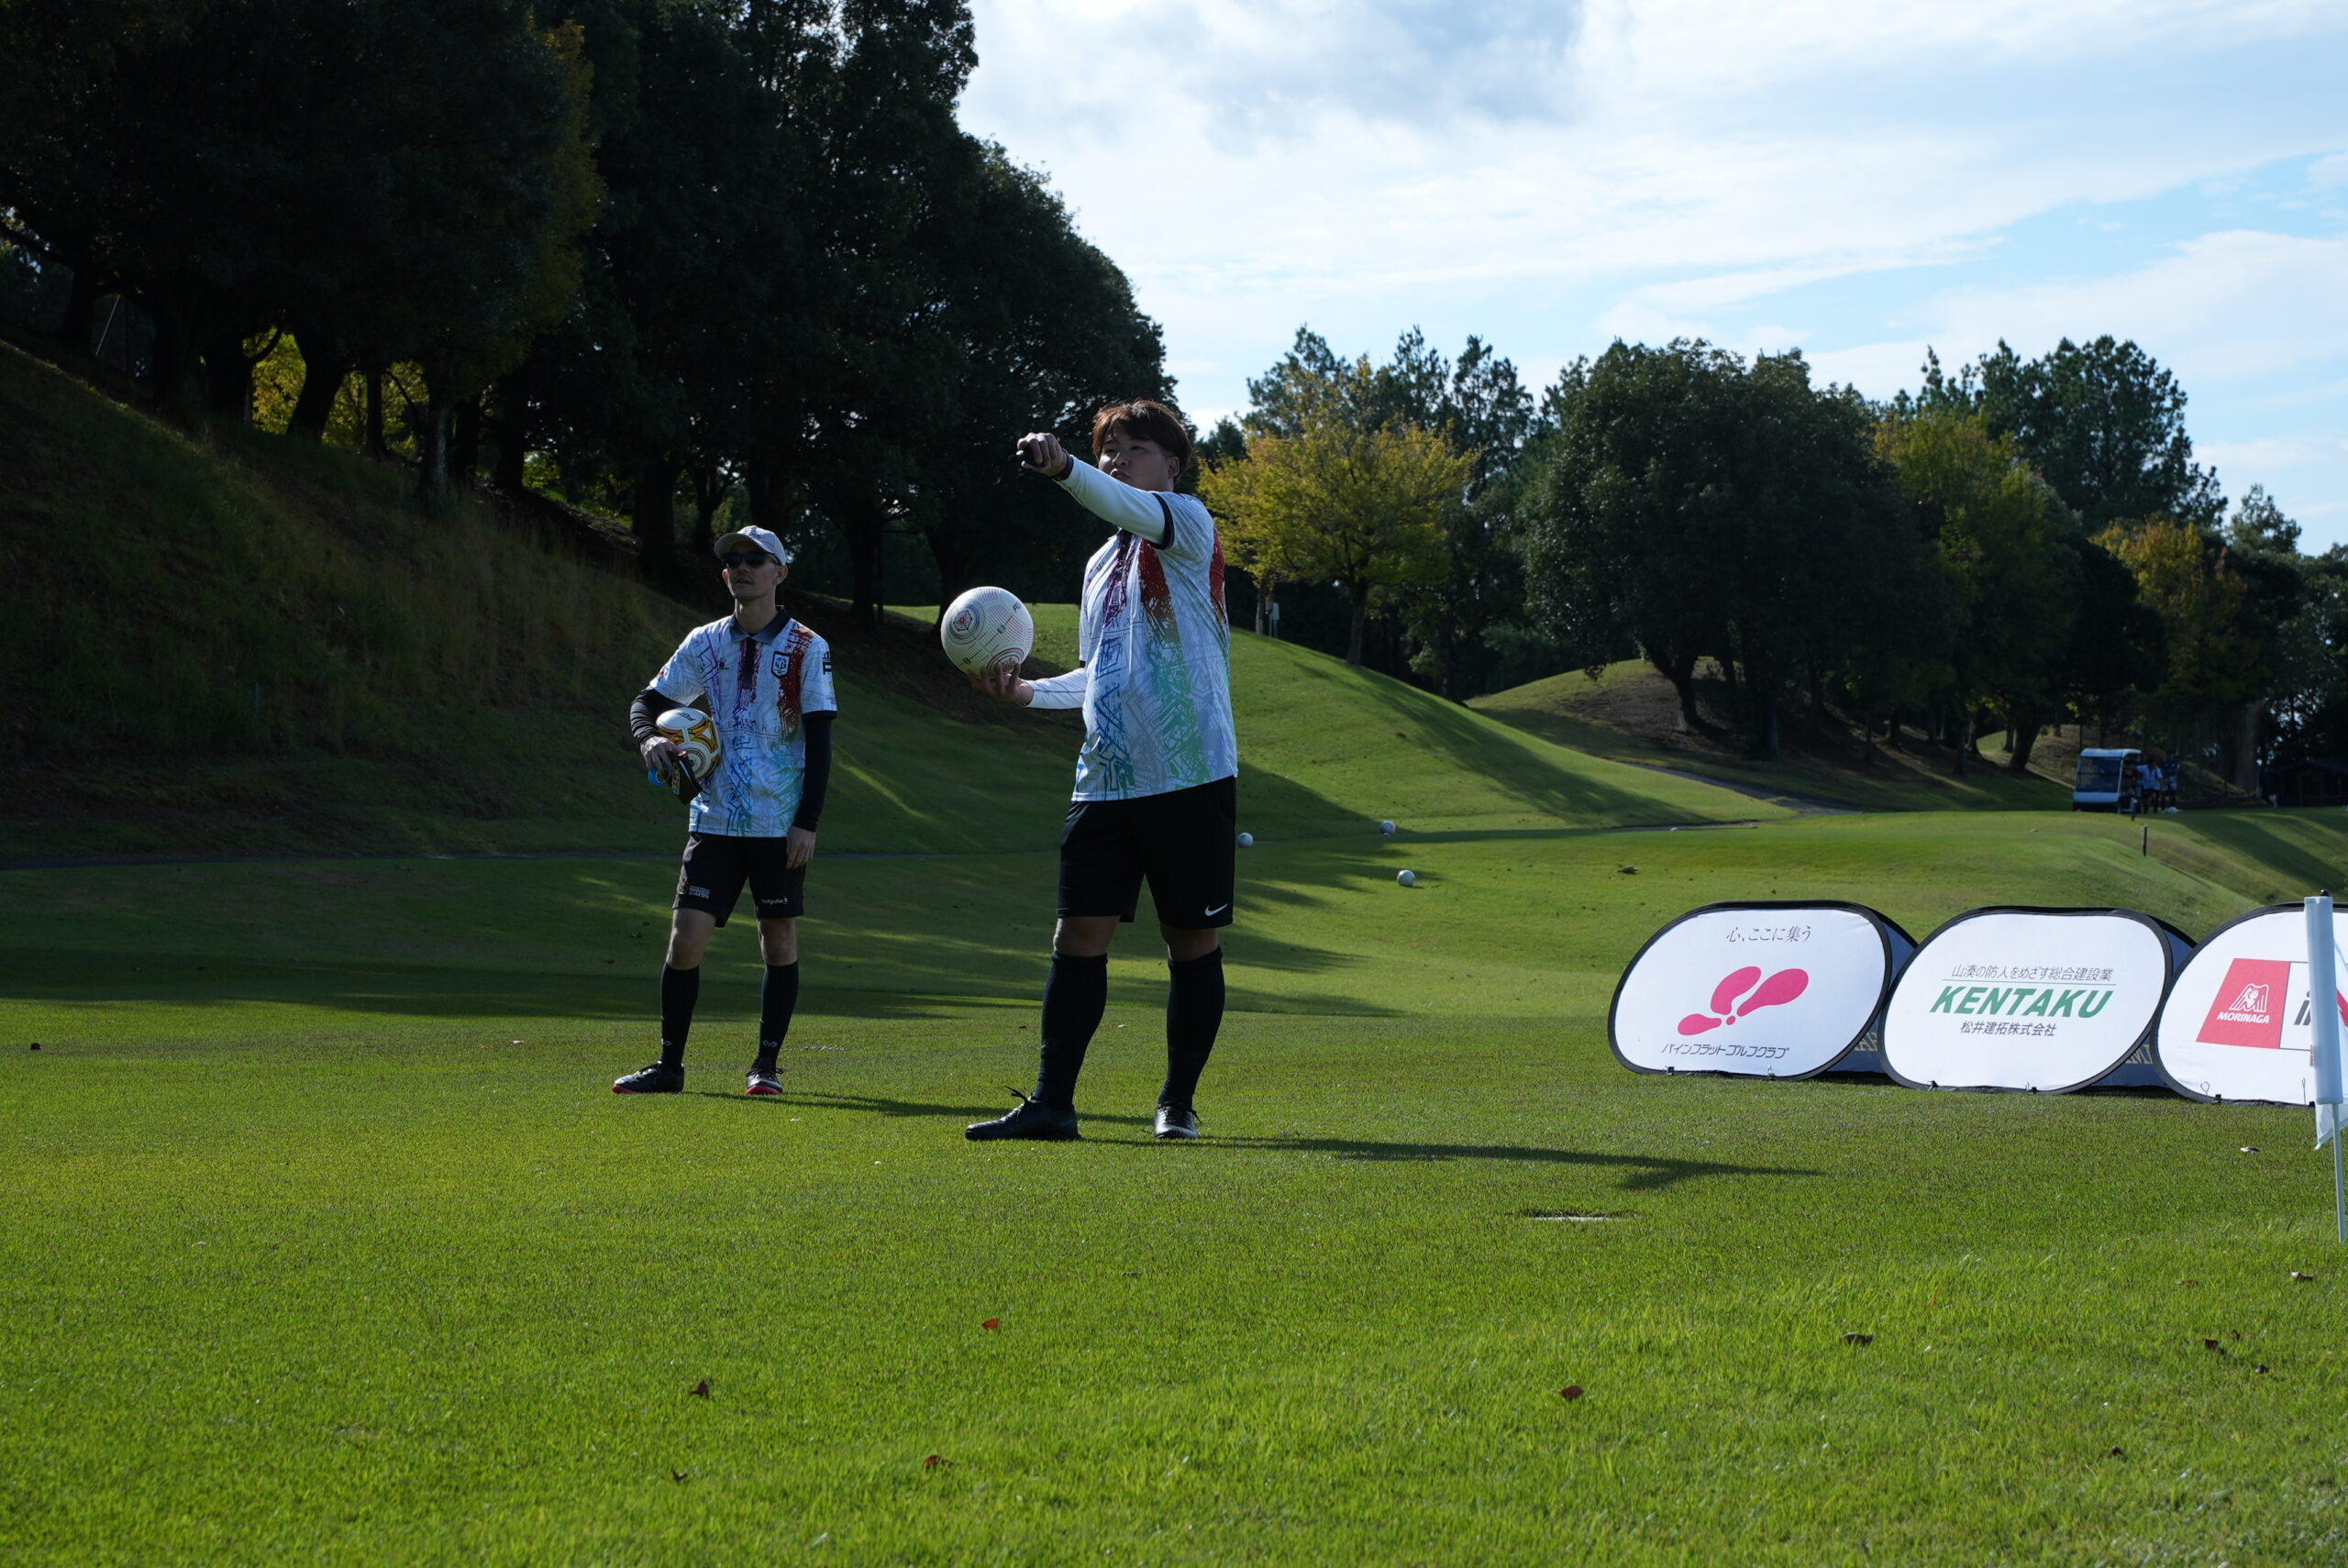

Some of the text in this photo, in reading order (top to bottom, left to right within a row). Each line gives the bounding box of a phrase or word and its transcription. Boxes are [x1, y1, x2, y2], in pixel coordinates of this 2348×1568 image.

[1725, 925, 1811, 944] 心、ここに集う
[1929, 986, 2114, 1019] KENTAKU
[2216, 1011, 2270, 1024] MORINAGA
[1960, 1020, 2057, 1037] 松井建拓株式会社
